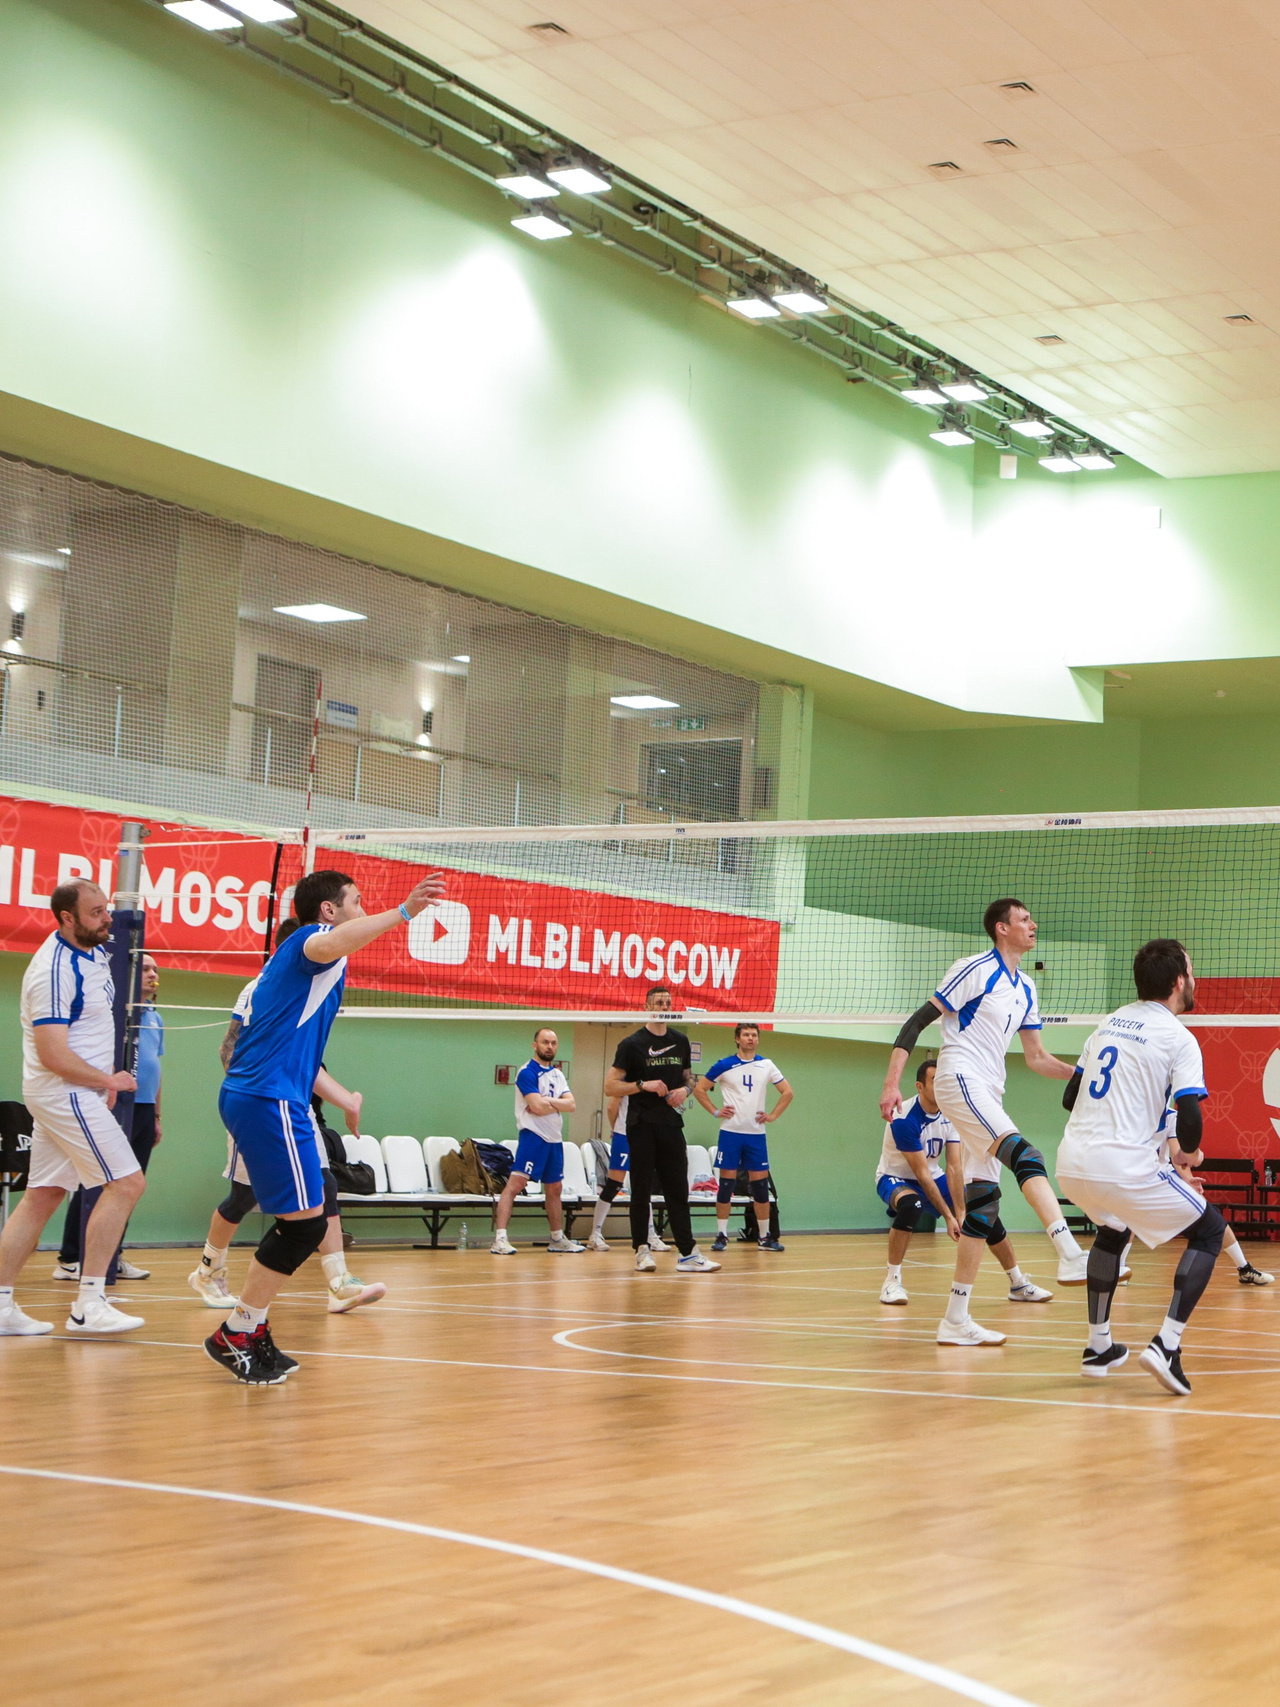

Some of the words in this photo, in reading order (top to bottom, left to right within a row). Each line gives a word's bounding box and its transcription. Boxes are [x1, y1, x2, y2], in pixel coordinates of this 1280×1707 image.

[486, 914, 741, 990] MLBLMOSCOW
[1003, 1013, 1012, 1034] 1
[1108, 1017, 1145, 1031] РОССЕТИ
[645, 1056, 683, 1067] VOLLEYBALL
[1089, 1046, 1119, 1100] 3
[742, 1074, 754, 1093] 4
[926, 1138, 944, 1158] 10
[620, 1153, 629, 1167] 7
[717, 1151, 724, 1164] 4
[524, 1161, 534, 1175] 6
[1051, 1226, 1068, 1239] FILA
[951, 1288, 967, 1297] FILA
